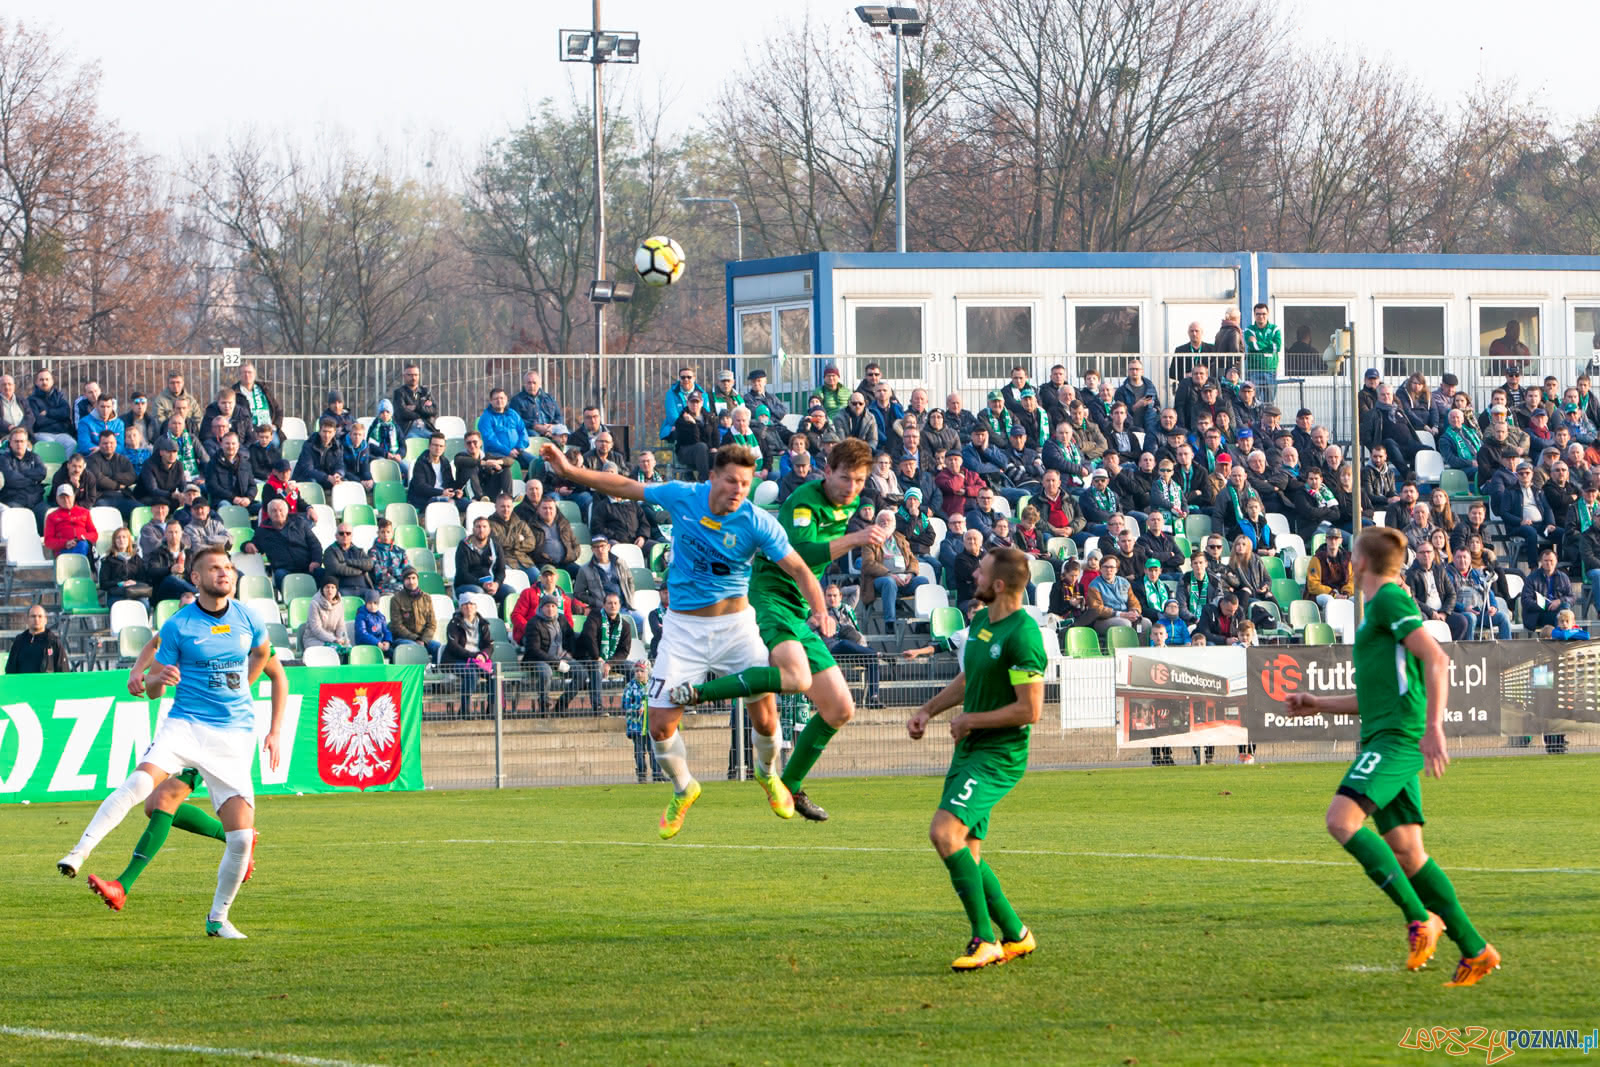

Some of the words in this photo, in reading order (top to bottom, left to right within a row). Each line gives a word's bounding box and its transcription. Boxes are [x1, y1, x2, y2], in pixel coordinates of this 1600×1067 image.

[225, 354, 240, 364] 32
[929, 352, 942, 362] 31
[1171, 669, 1222, 692] futbolsport.pl
[1264, 712, 1329, 729] Poznań,
[1333, 713, 1354, 726] ul.
[1468, 706, 1488, 721] 1a
[1354, 751, 1382, 774] 13
[957, 777, 978, 800] 5
